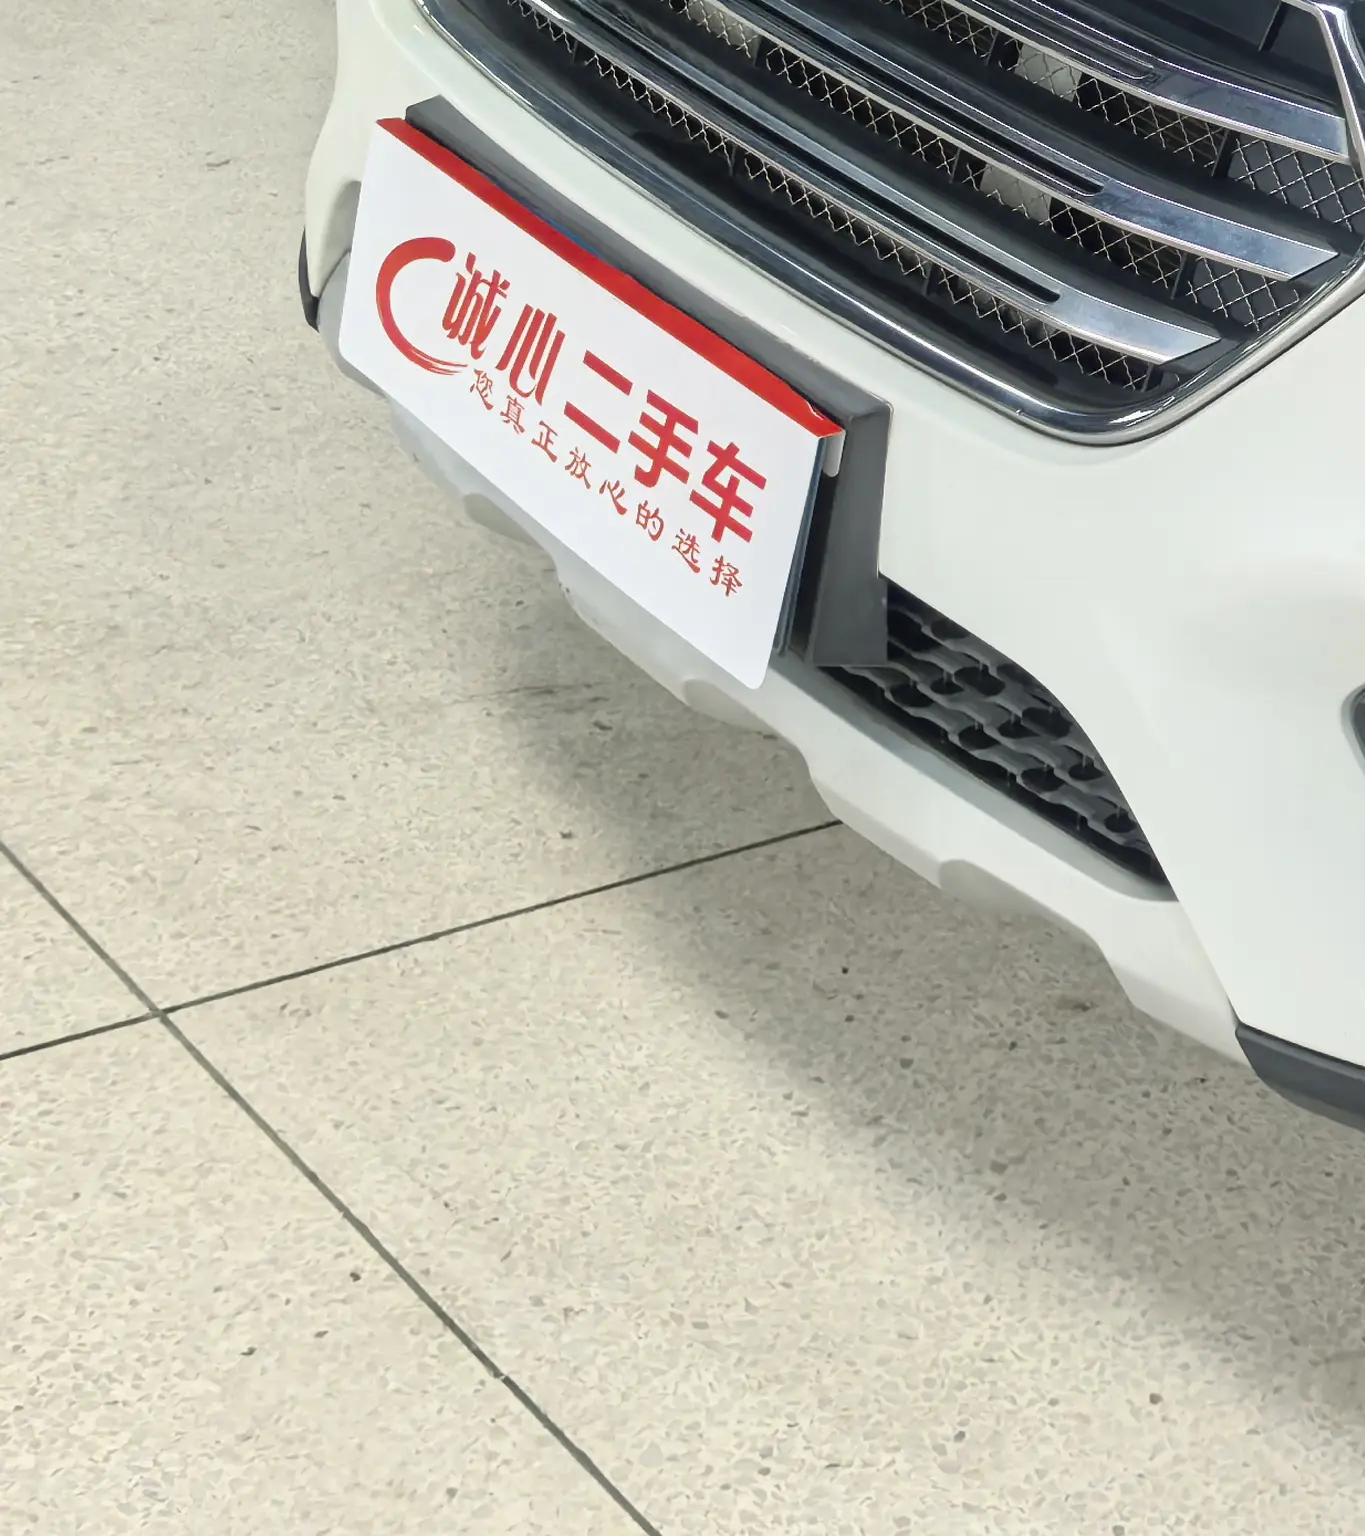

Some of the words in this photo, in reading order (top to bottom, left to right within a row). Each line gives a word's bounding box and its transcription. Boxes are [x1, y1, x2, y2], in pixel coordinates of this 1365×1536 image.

[440, 252, 767, 545] 诚心二手车
[468, 368, 744, 598] 您真正放心的选择
